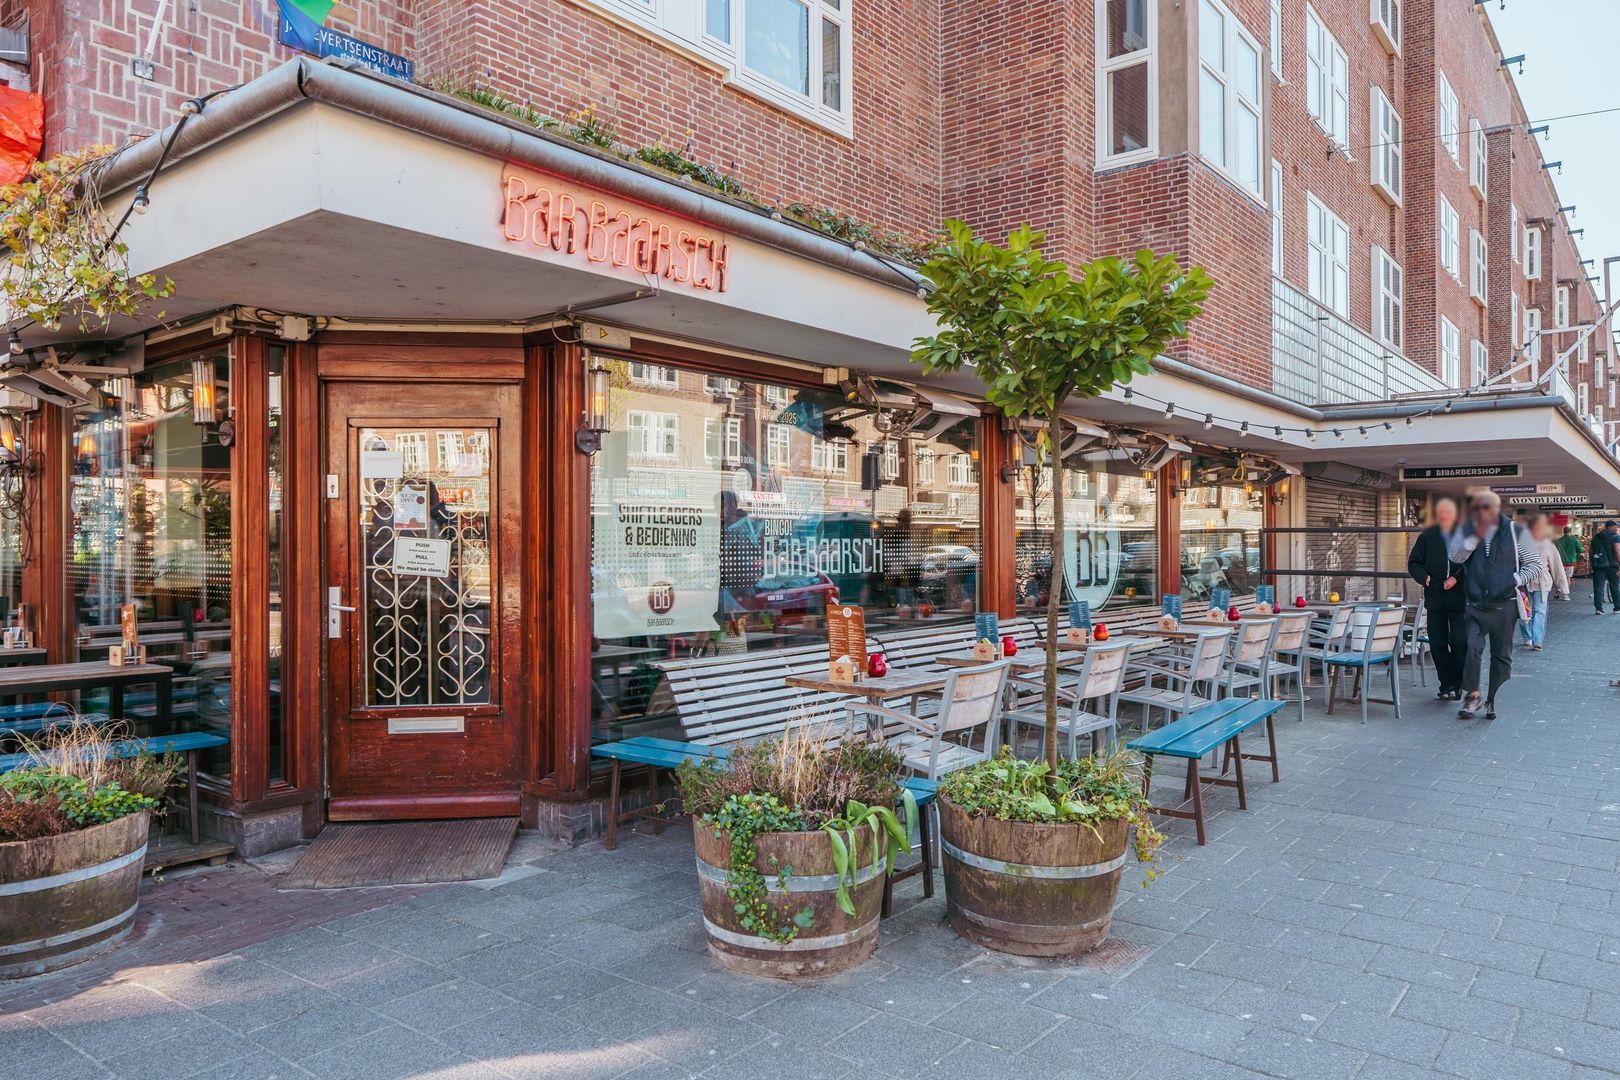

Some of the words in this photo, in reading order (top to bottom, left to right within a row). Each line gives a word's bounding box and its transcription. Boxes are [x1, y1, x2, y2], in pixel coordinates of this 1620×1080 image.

[780, 411, 797, 425] 2025
[618, 503, 703, 526] SHIFTLEADERS
[625, 526, 634, 546] &
[636, 526, 697, 547] BEDIENING
[764, 519, 793, 536] BINGO!
[654, 586, 670, 609] BB
